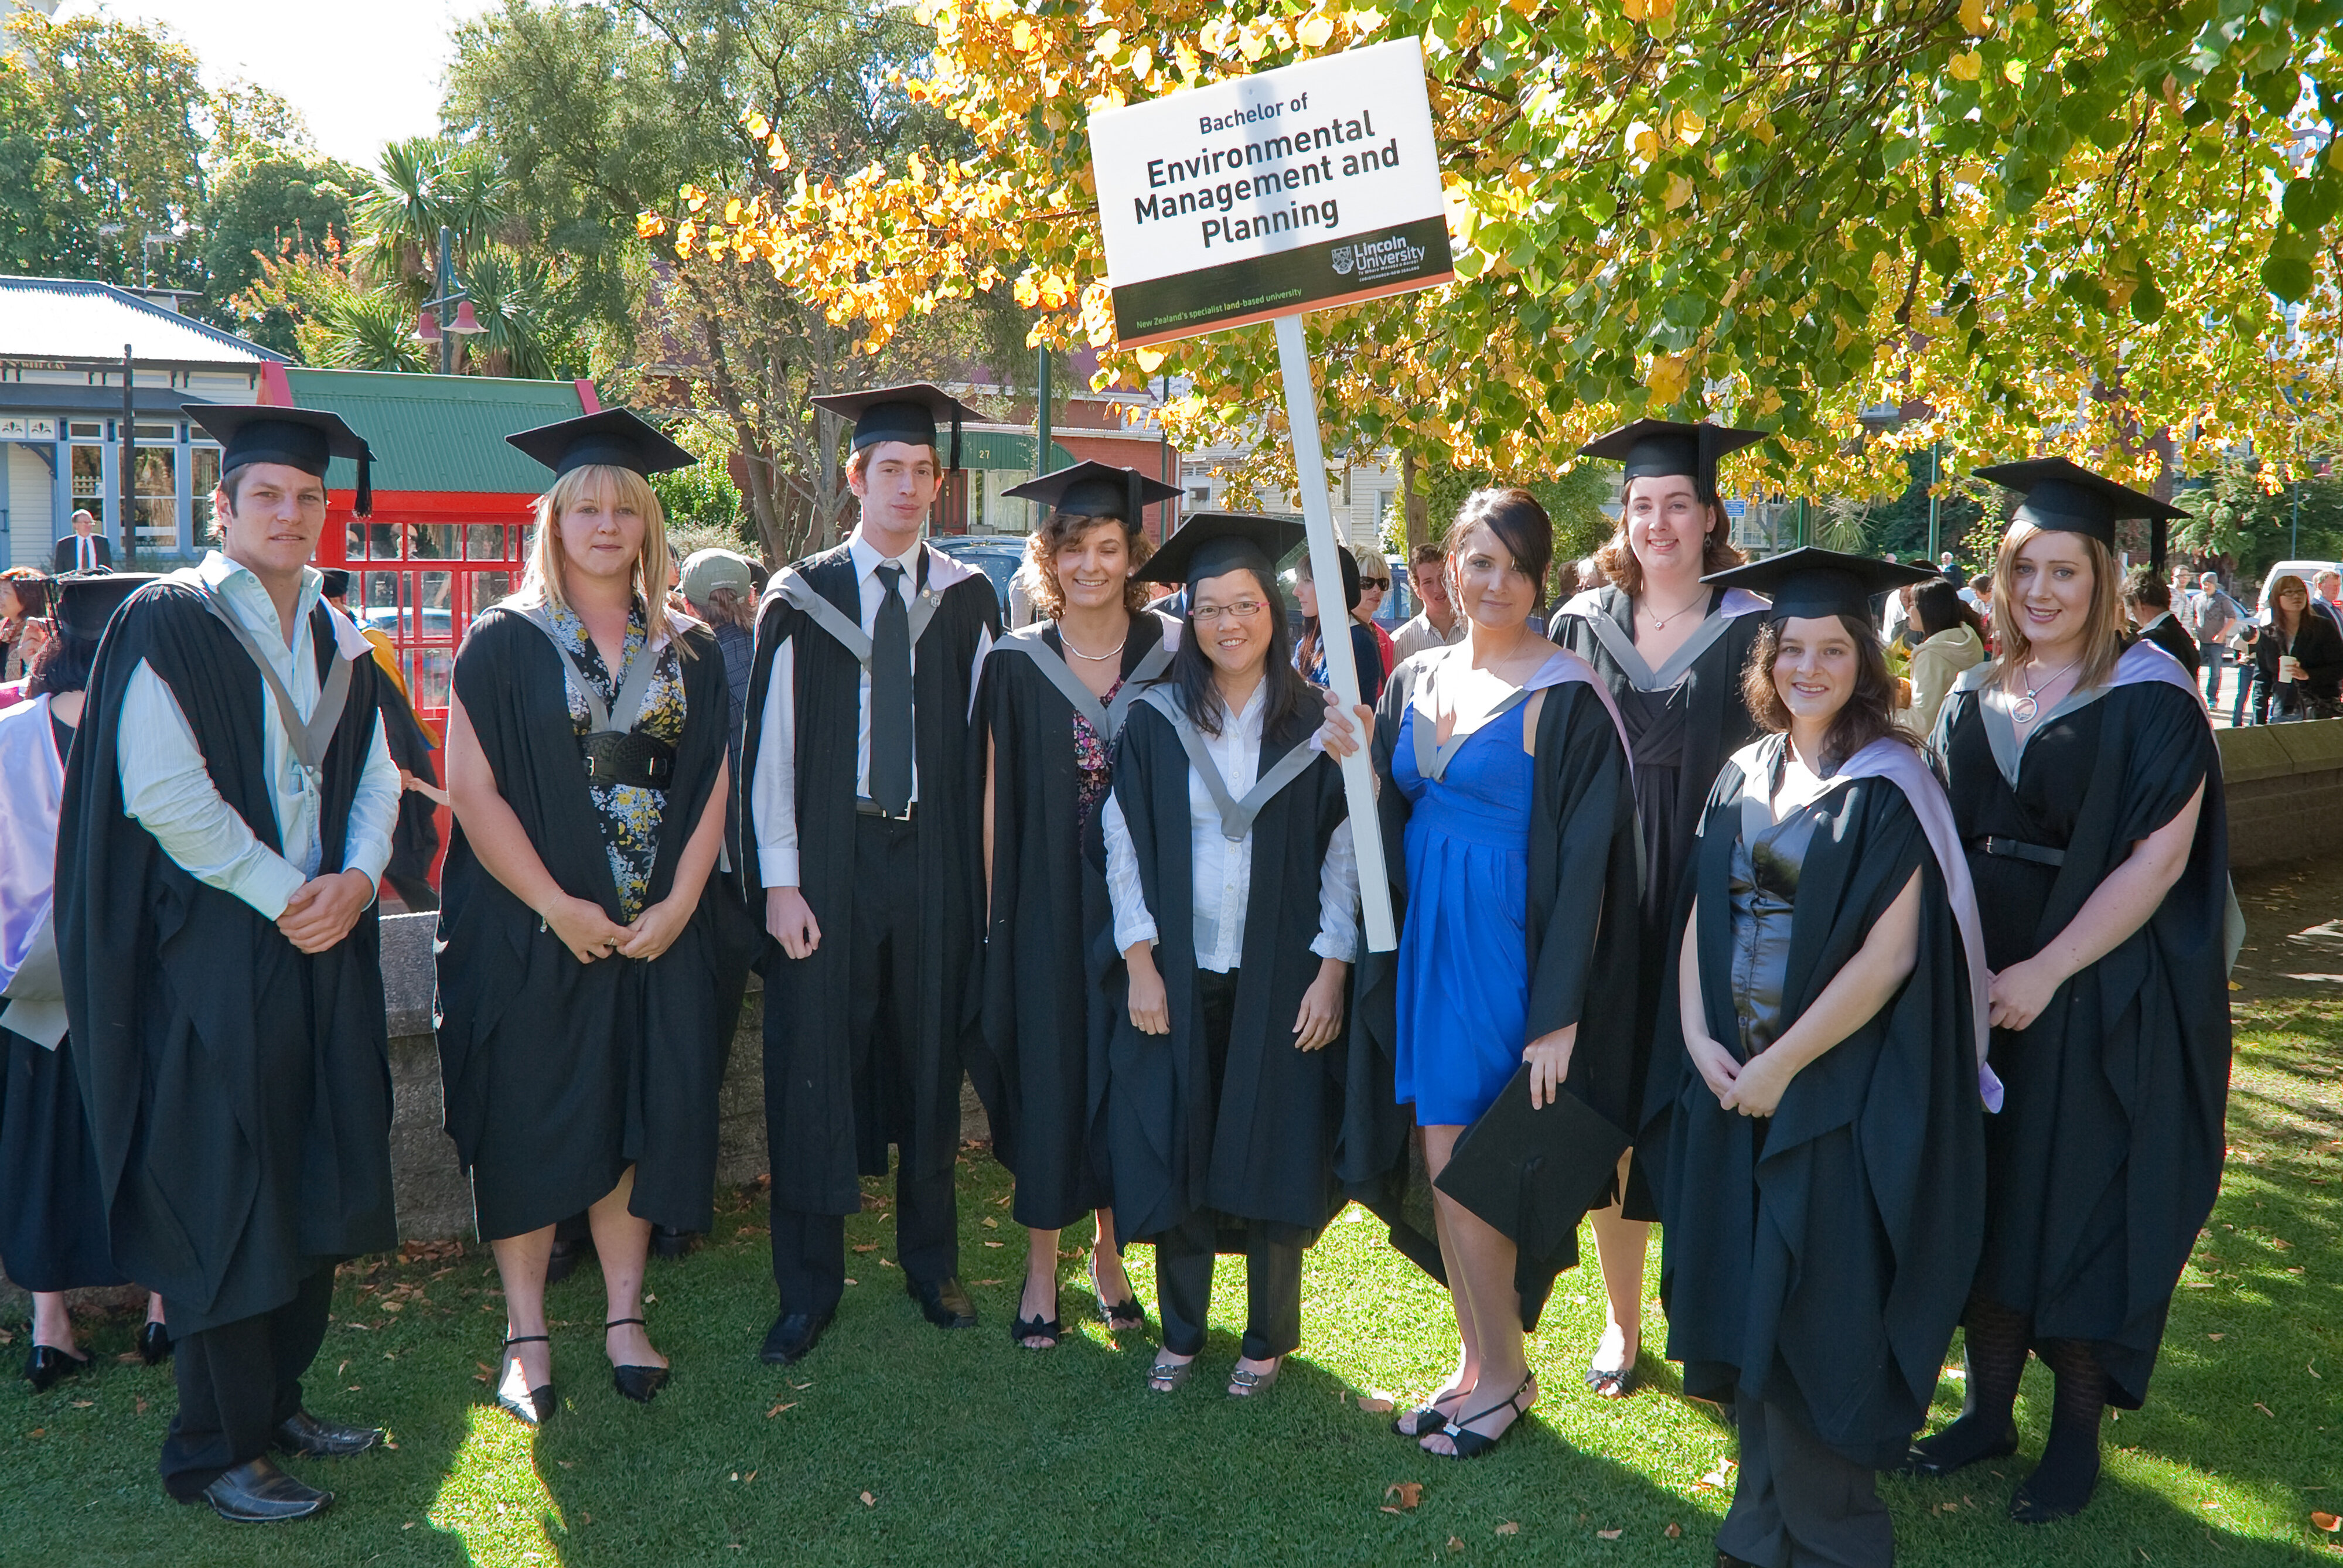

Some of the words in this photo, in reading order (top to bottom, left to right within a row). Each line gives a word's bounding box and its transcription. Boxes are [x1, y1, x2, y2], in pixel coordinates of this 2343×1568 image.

[1199, 102, 1284, 135] Bachelor
[1290, 92, 1308, 113] of
[1147, 110, 1375, 188] Environmental
[1134, 155, 1333, 224] Management
[1342, 138, 1399, 176] and
[1202, 199, 1339, 248] Planning
[1354, 236, 1407, 258] Lincoln
[1356, 246, 1425, 271] University
[1136, 319, 1153, 329] New
[1154, 312, 1188, 326] Zealand's
[1189, 305, 1223, 319] specialist
[1266, 288, 1302, 302] university
[979, 449, 990, 459] 27
